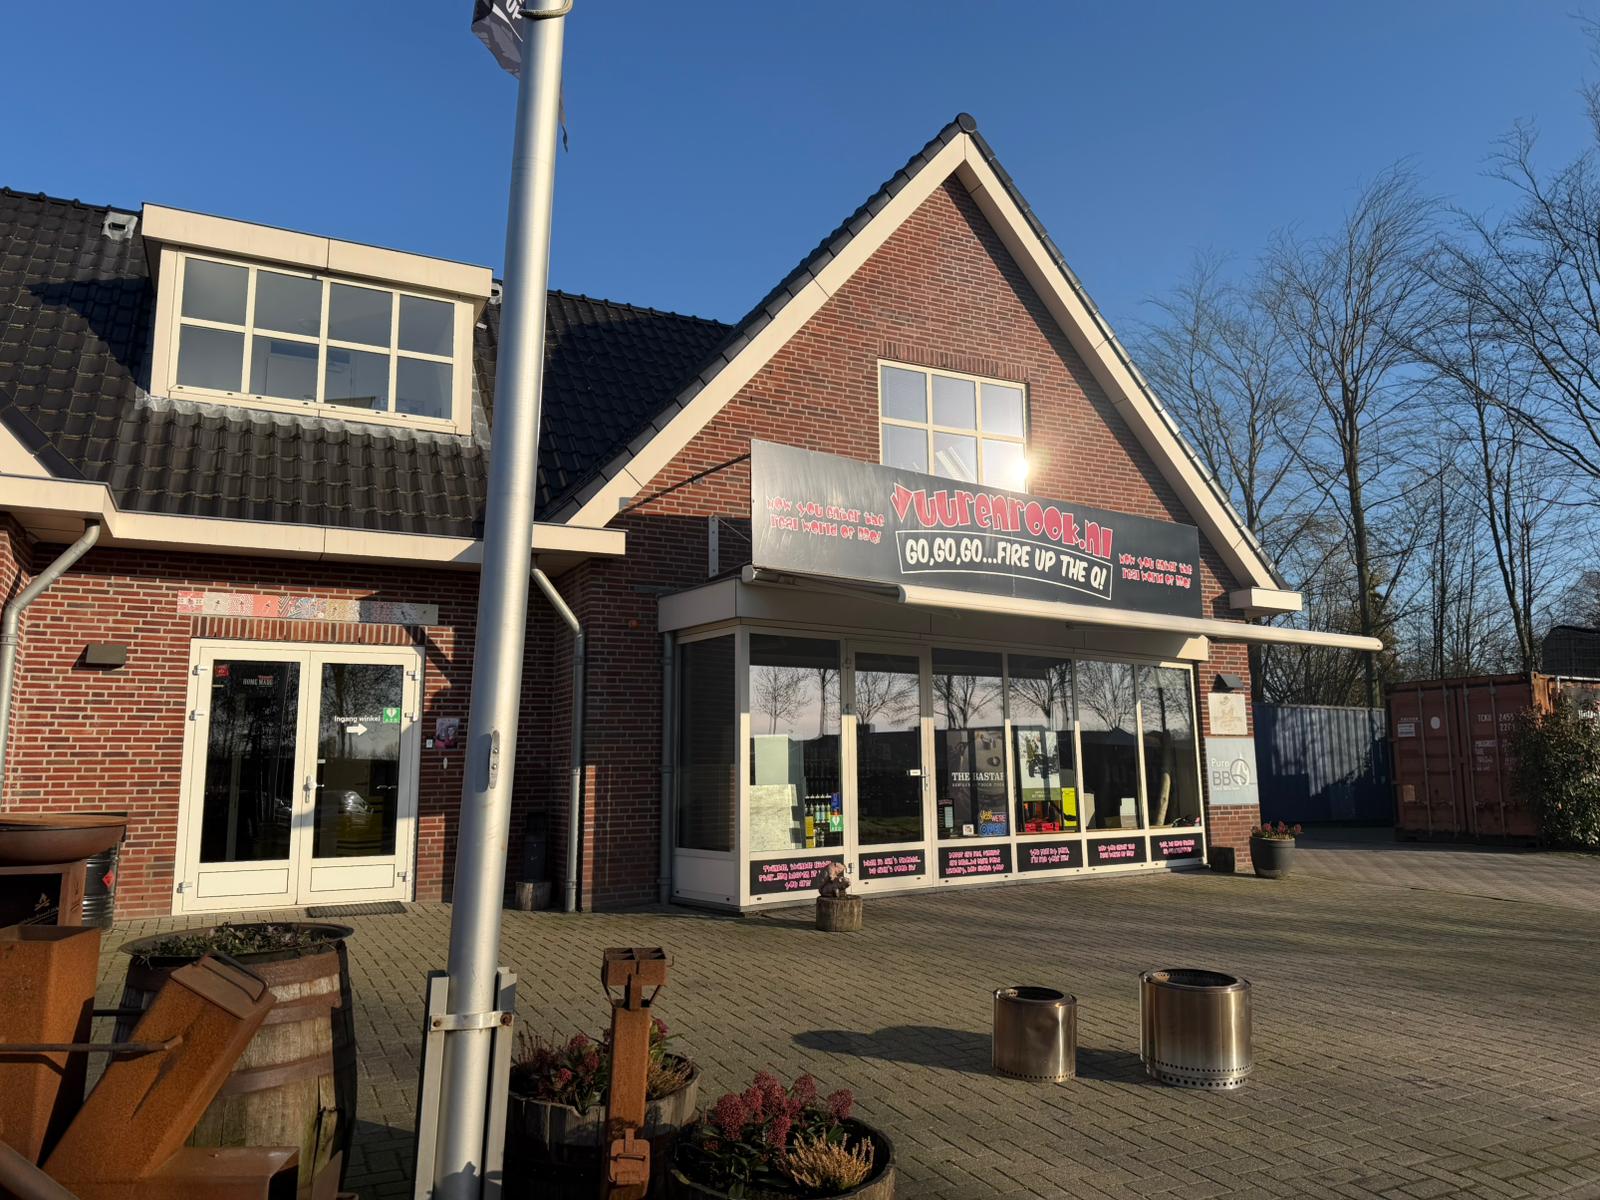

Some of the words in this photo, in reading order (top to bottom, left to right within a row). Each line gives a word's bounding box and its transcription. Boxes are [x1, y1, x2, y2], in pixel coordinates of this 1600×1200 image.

[1034, 549, 1056, 573] UP
[1060, 554, 1088, 583] THE
[1090, 568, 1108, 590] Q!
[334, 715, 358, 723] Ingang
[359, 714, 381, 722] winkel
[952, 772, 970, 781] THE
